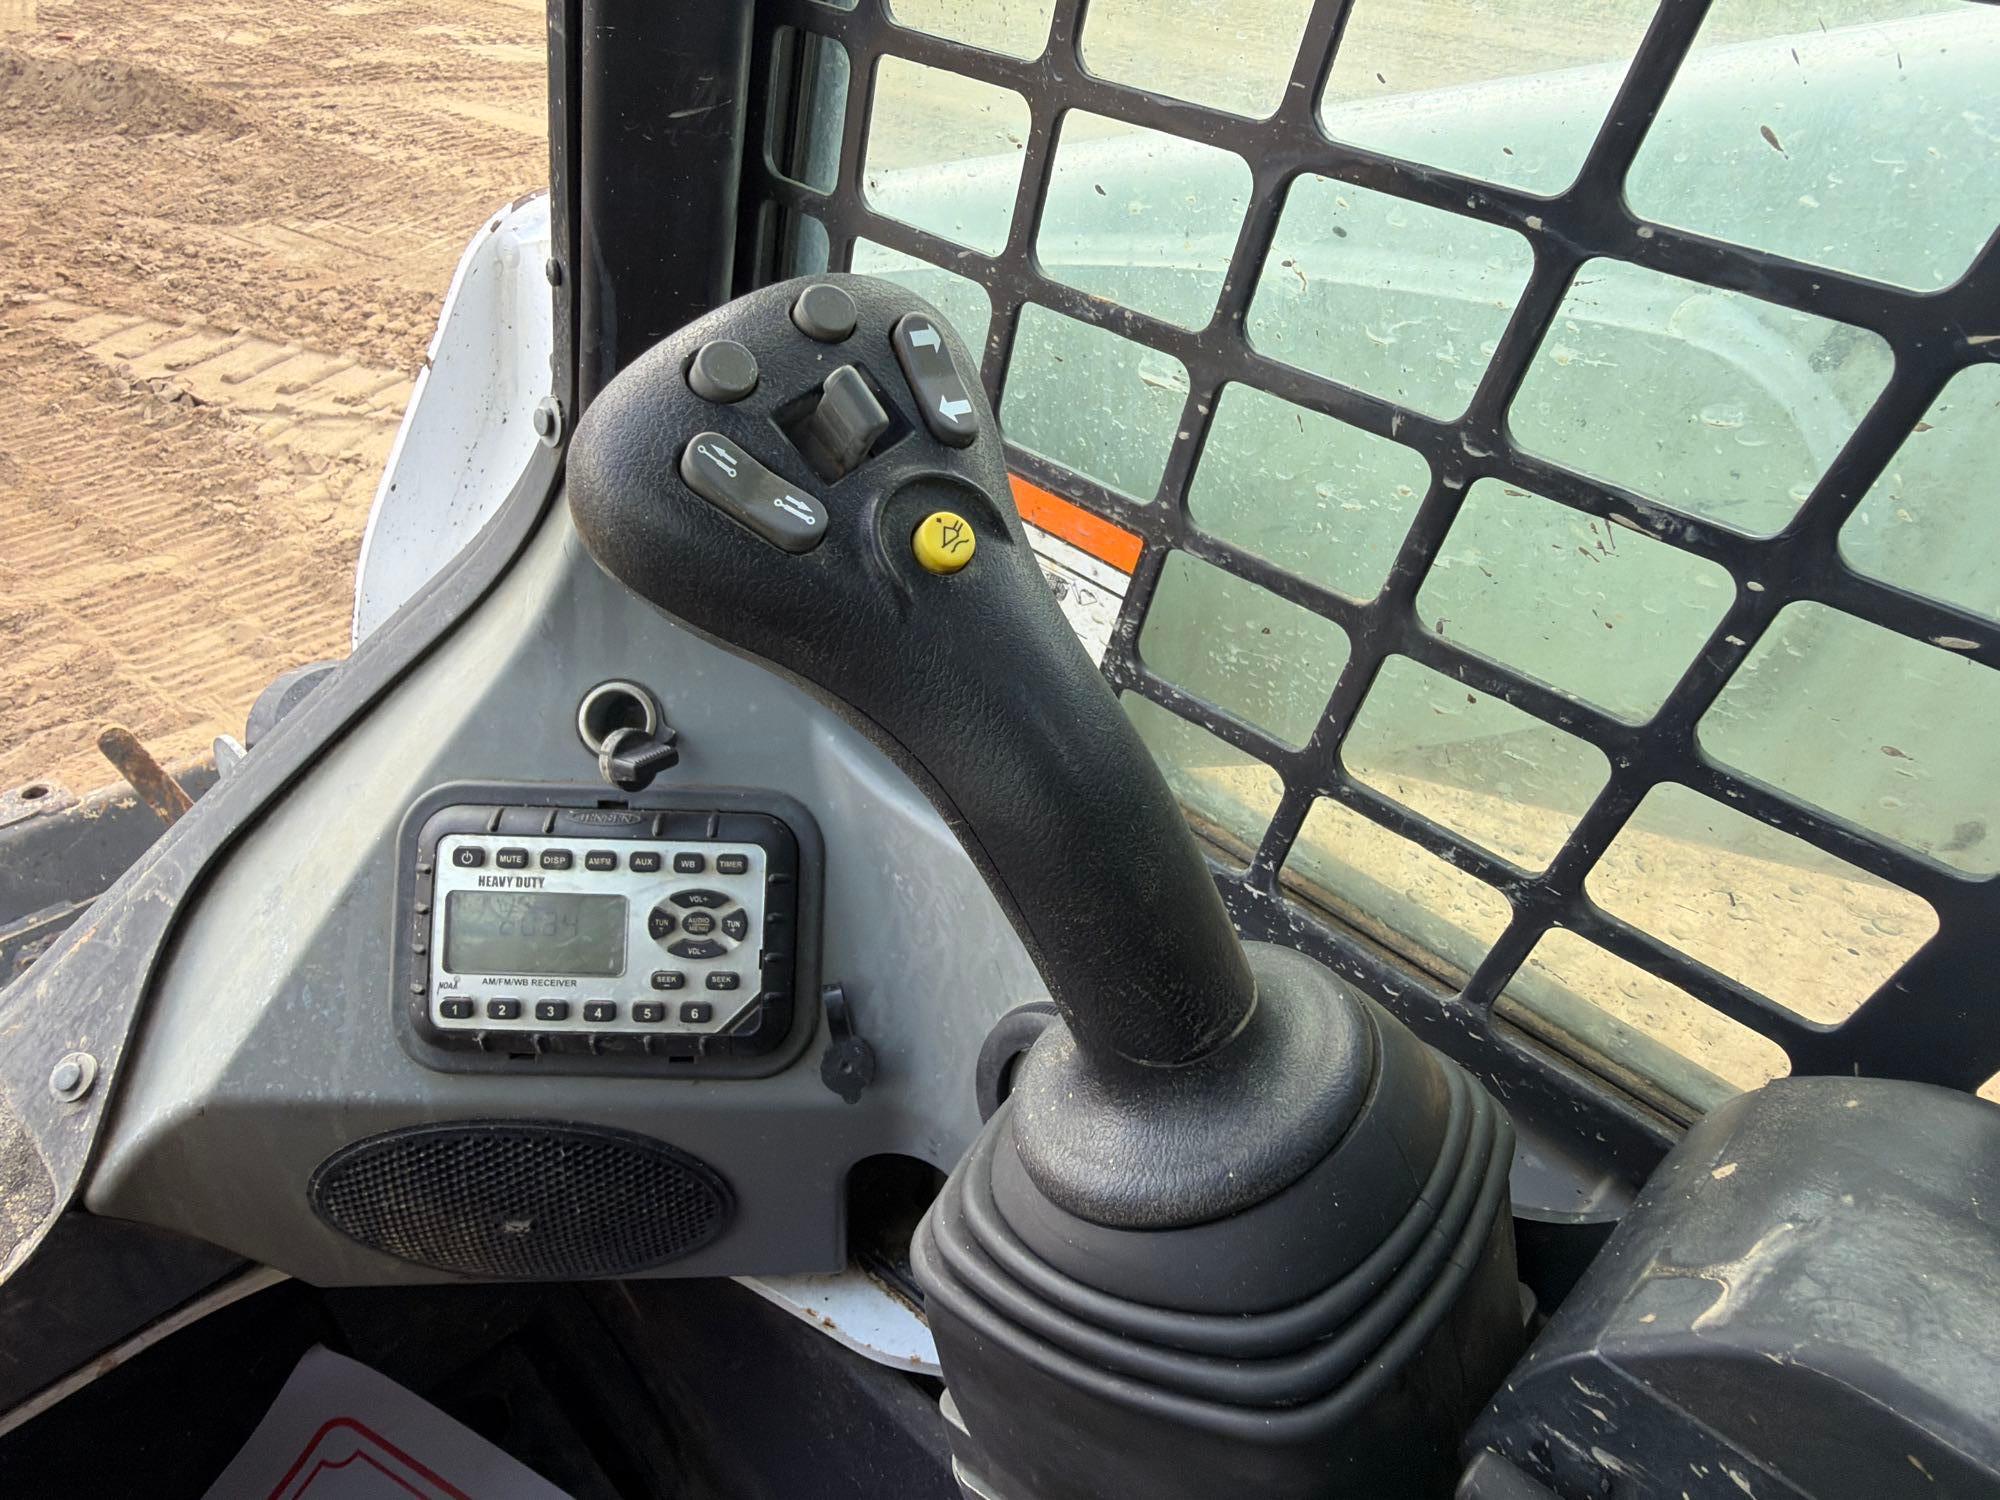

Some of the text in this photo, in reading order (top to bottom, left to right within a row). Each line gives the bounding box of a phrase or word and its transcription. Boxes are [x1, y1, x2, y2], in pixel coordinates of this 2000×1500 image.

[499, 855, 522, 863] MUTE
[543, 856, 566, 865] DISP
[588, 857, 612, 865] AM/FM
[634, 857, 653, 866] AUX
[680, 860, 696, 868] WB
[719, 860, 743, 868] TIMER
[478, 875, 545, 889] HEAVY DUTY
[655, 918, 669, 926] TUN
[726, 920, 740, 928] TUN
[481, 977, 577, 988] AM/FM/WB RECEIVER
[451, 1005, 458, 1015] 1
[498, 1005, 506, 1016] 2
[547, 1006, 555, 1017] 3
[594, 1007, 602, 1018] 4
[643, 1008, 652, 1018] 5
[690, 1008, 699, 1019] 6
